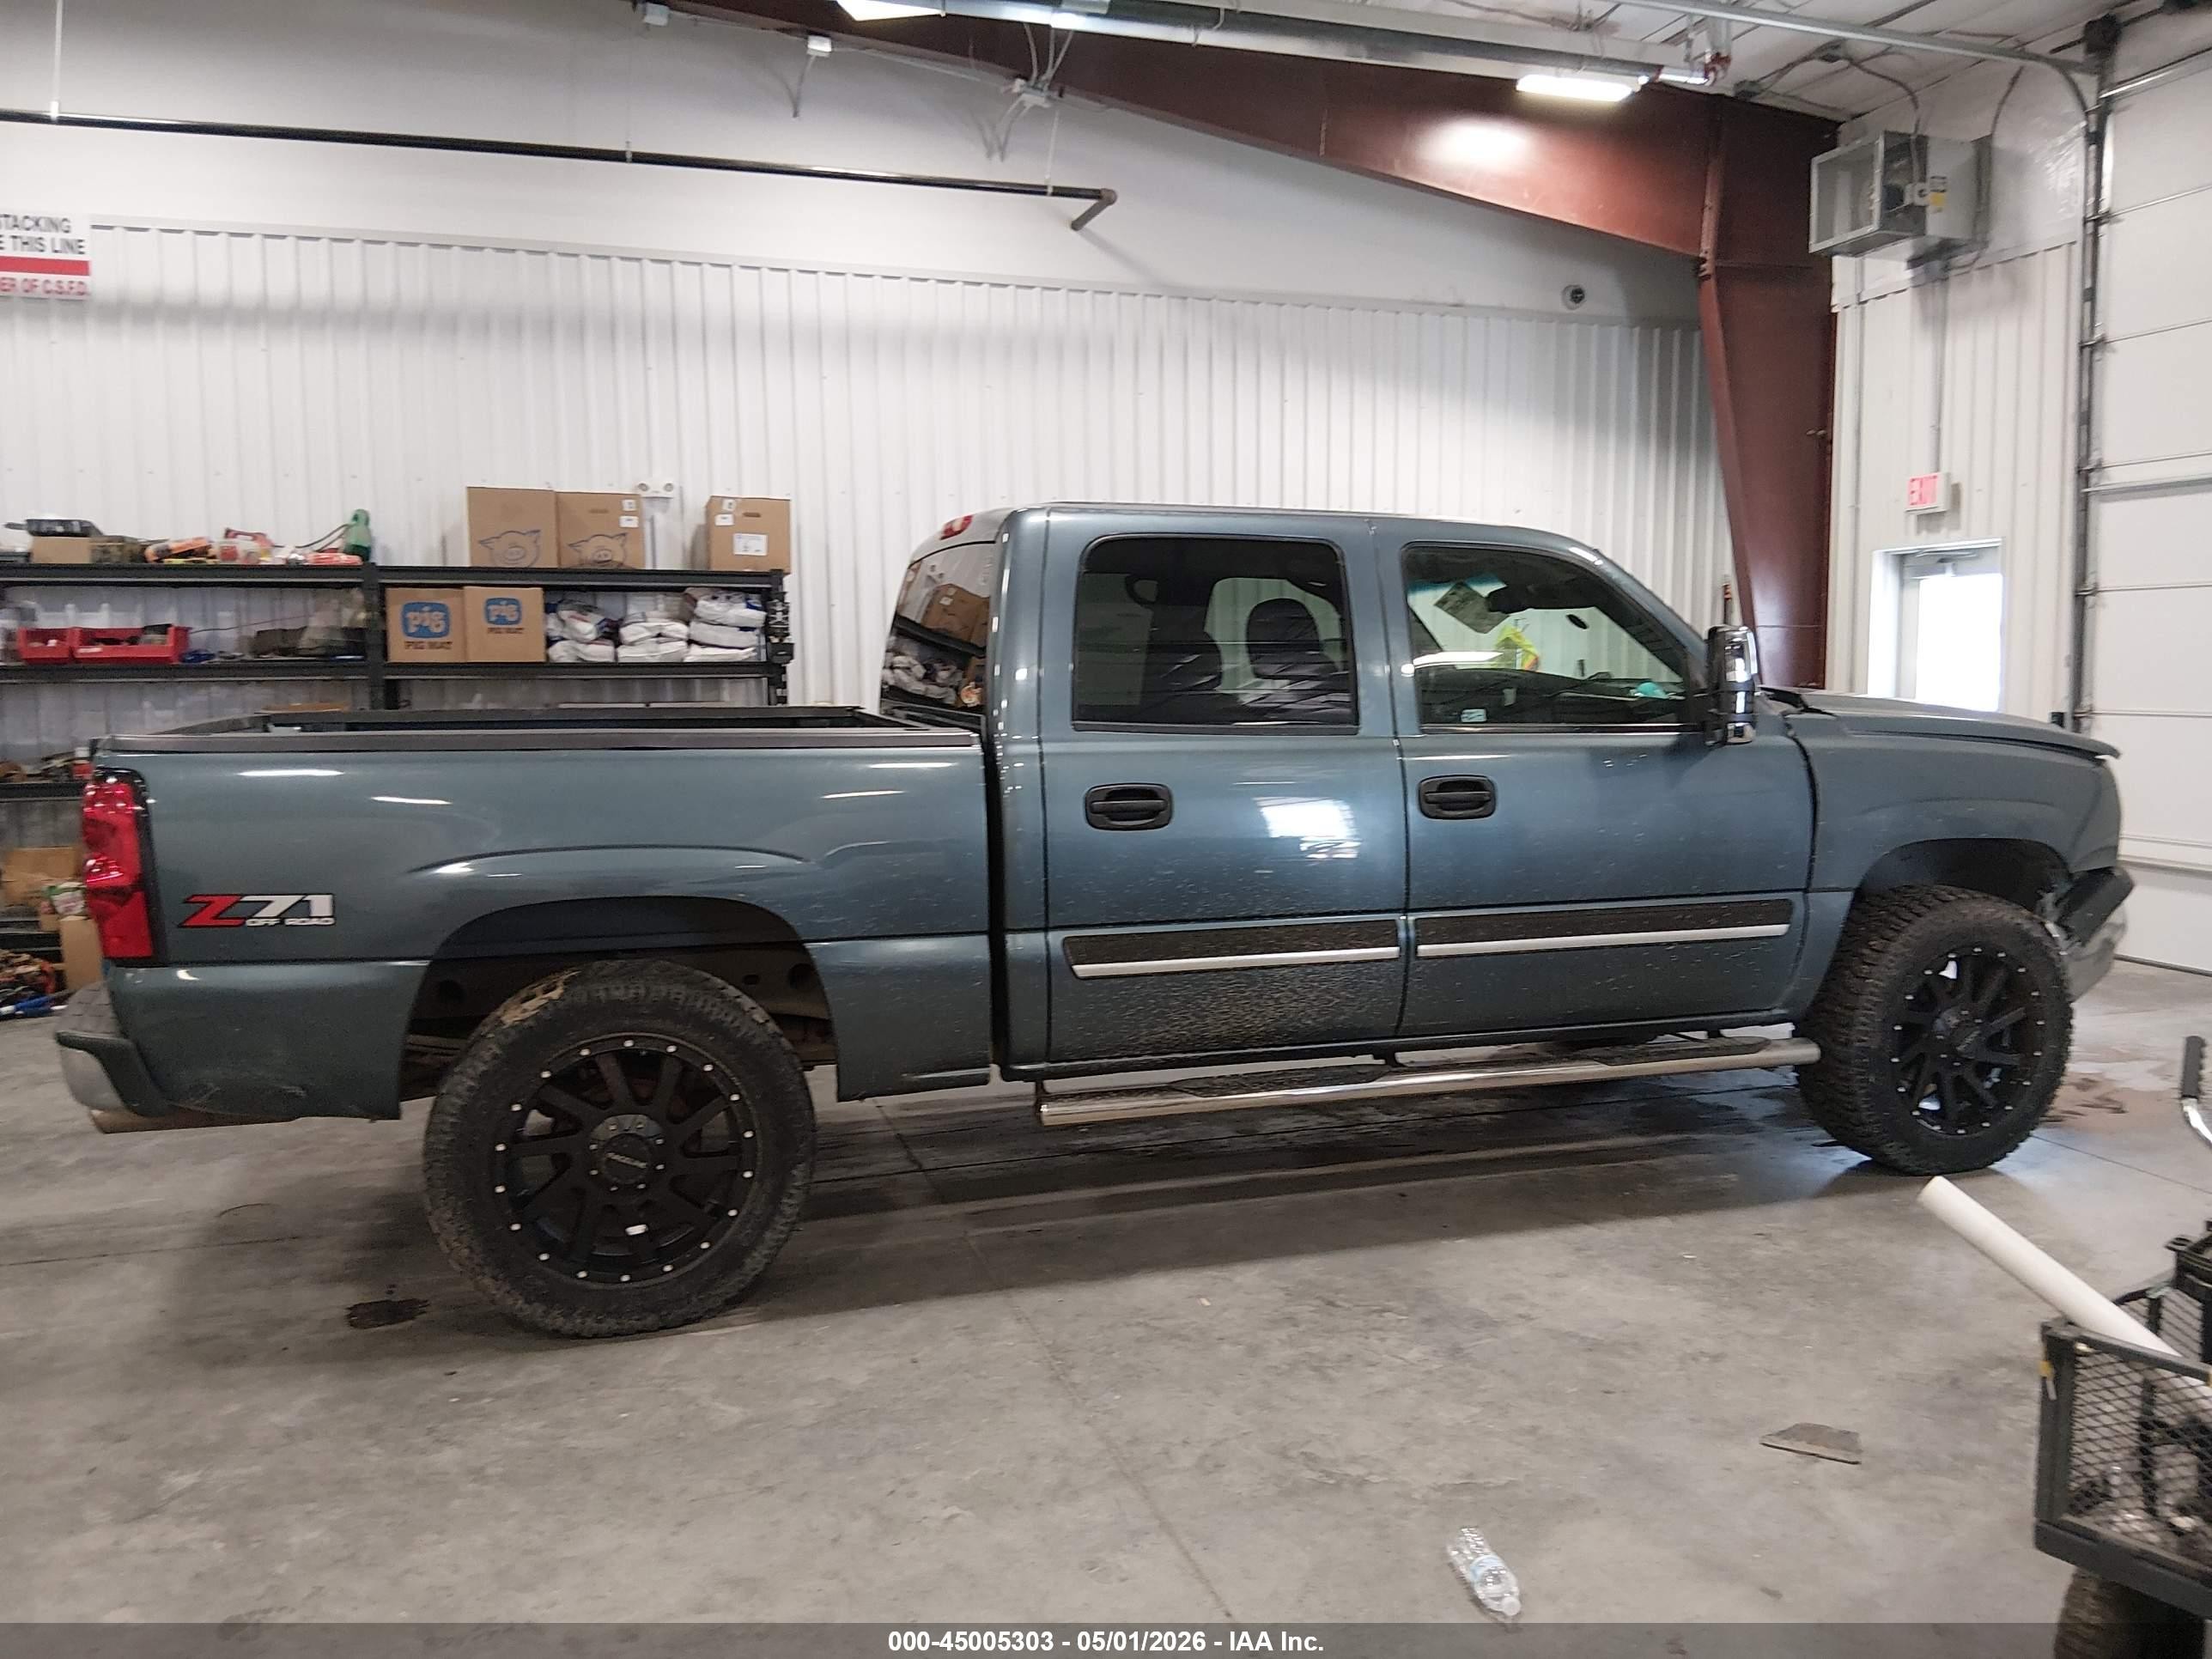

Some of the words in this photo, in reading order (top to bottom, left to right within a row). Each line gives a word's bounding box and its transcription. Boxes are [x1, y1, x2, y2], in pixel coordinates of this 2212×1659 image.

[0, 214, 71, 234] TACKING
[10, 234, 46, 253] THIS
[51, 237, 86, 255] LINE
[21, 278, 39, 294] OF
[179, 894, 334, 927] Z71
[246, 917, 282, 927] OFF
[284, 917, 335, 926] ROAD
